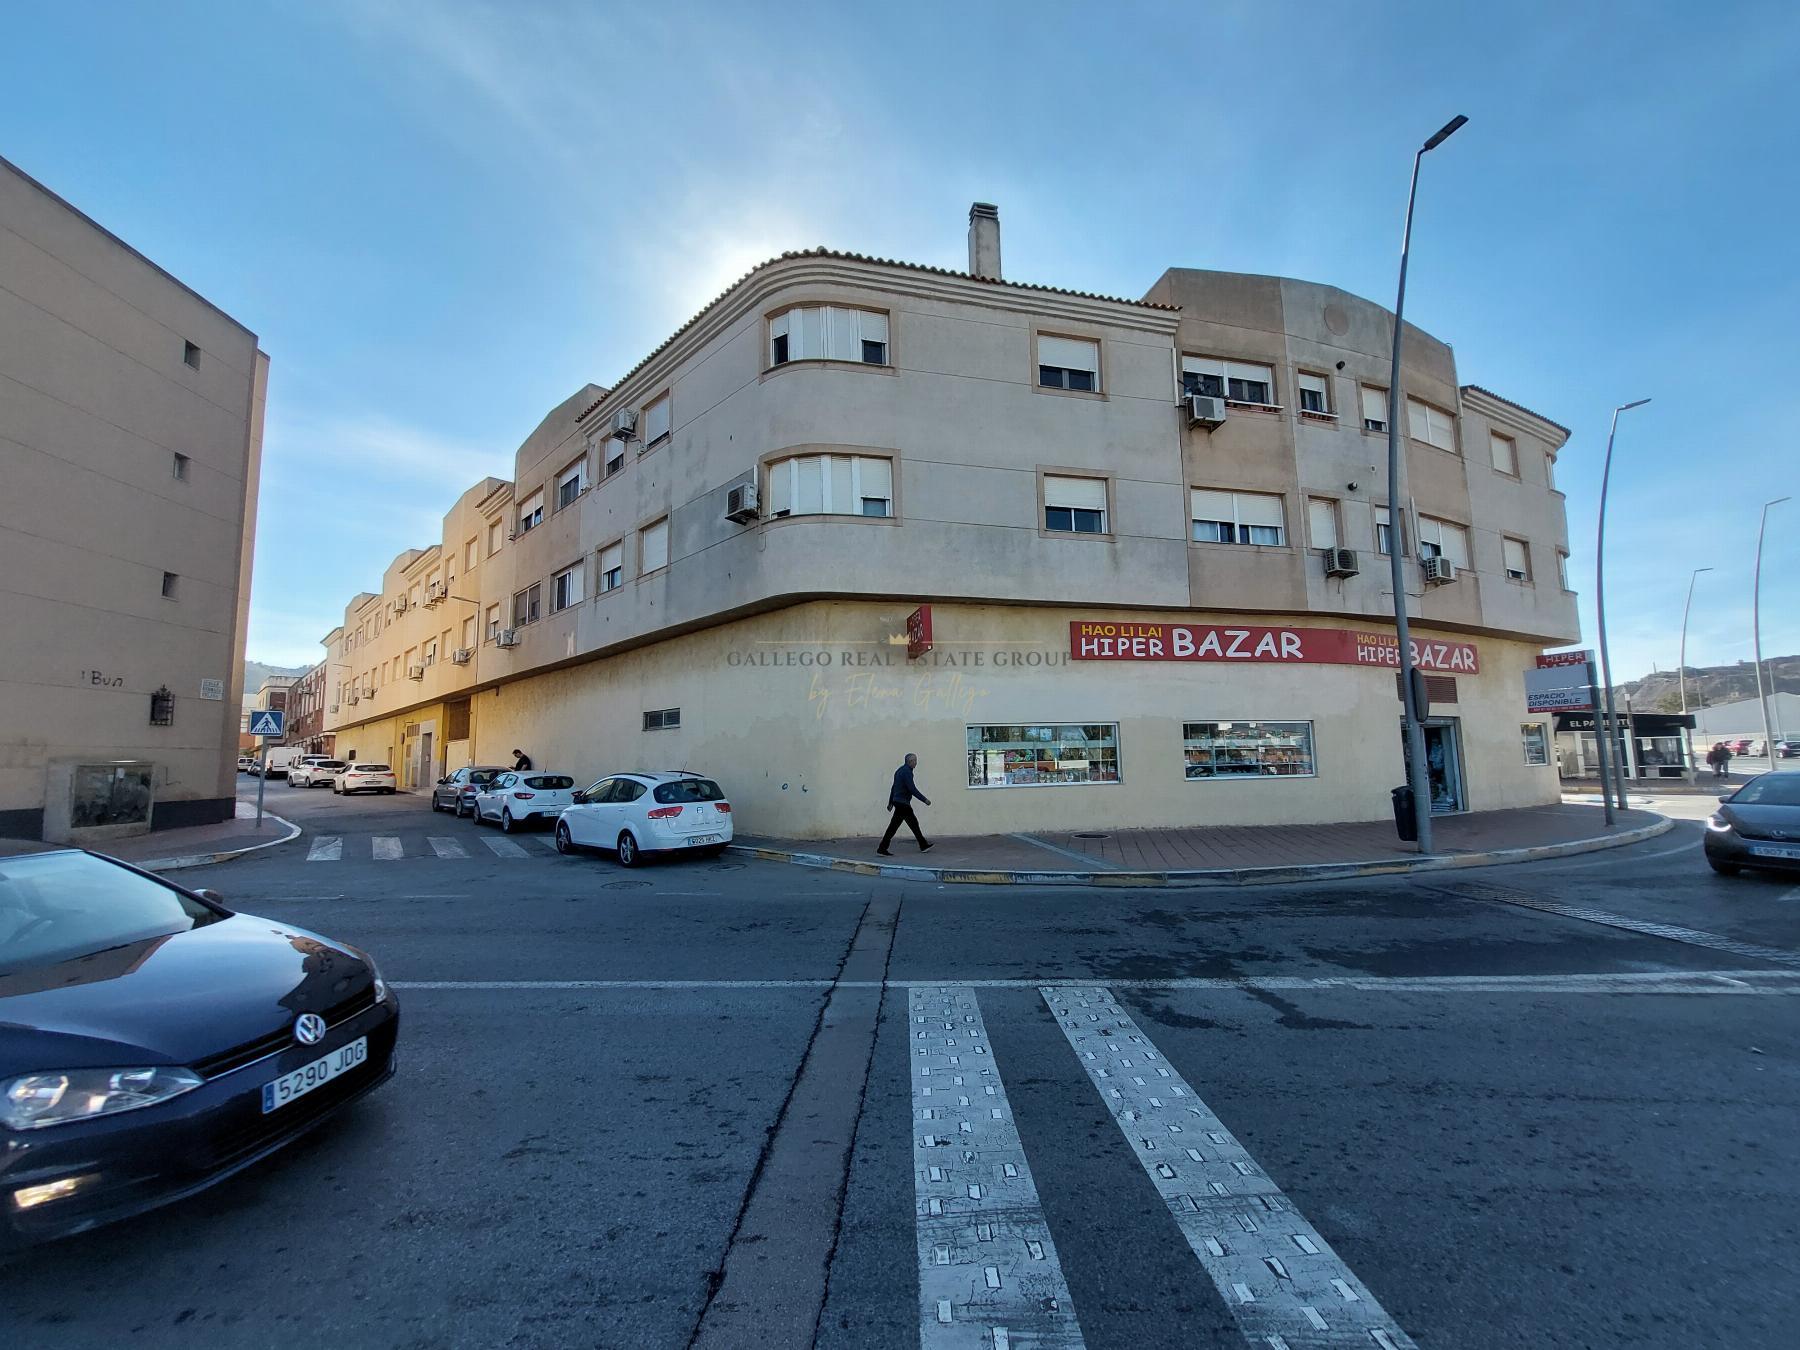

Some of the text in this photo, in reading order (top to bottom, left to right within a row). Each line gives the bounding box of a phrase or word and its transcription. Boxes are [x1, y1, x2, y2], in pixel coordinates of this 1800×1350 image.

[1081, 624, 1163, 638] HAO LI LAI
[1081, 628, 1304, 659] HIPER BAZAR
[1357, 634, 1399, 647] HAO LI LA
[1409, 641, 1477, 671] BAZAR
[1546, 652, 1583, 663] HIPER
[1527, 692, 1566, 701] ESPACIO
[1528, 698, 1582, 707] DISPONIBLE
[1569, 720, 1582, 728] EL
[279, 1042, 364, 1100] 5290 JDG
